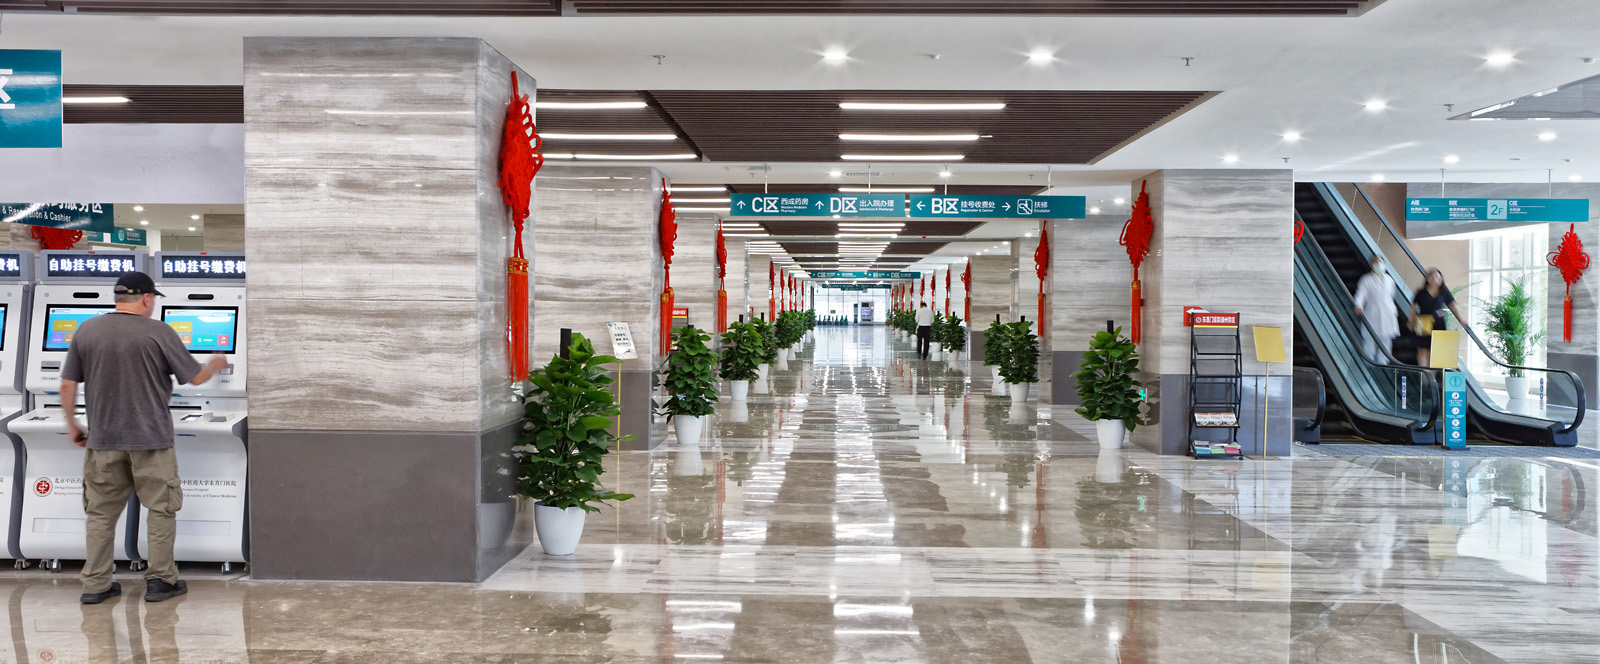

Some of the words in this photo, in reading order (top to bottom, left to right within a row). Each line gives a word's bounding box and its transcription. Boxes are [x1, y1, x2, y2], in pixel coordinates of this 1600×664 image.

[752, 197, 779, 213] C区
[830, 197, 858, 213] D区
[932, 198, 959, 214] B区
[1490, 204, 1504, 216] 2F
[43, 210, 49, 220] &
[49, 211, 71, 222] Cashier
[49, 258, 135, 272] 自助挂号缴费机
[163, 260, 246, 273] 自助挂号缴费机
